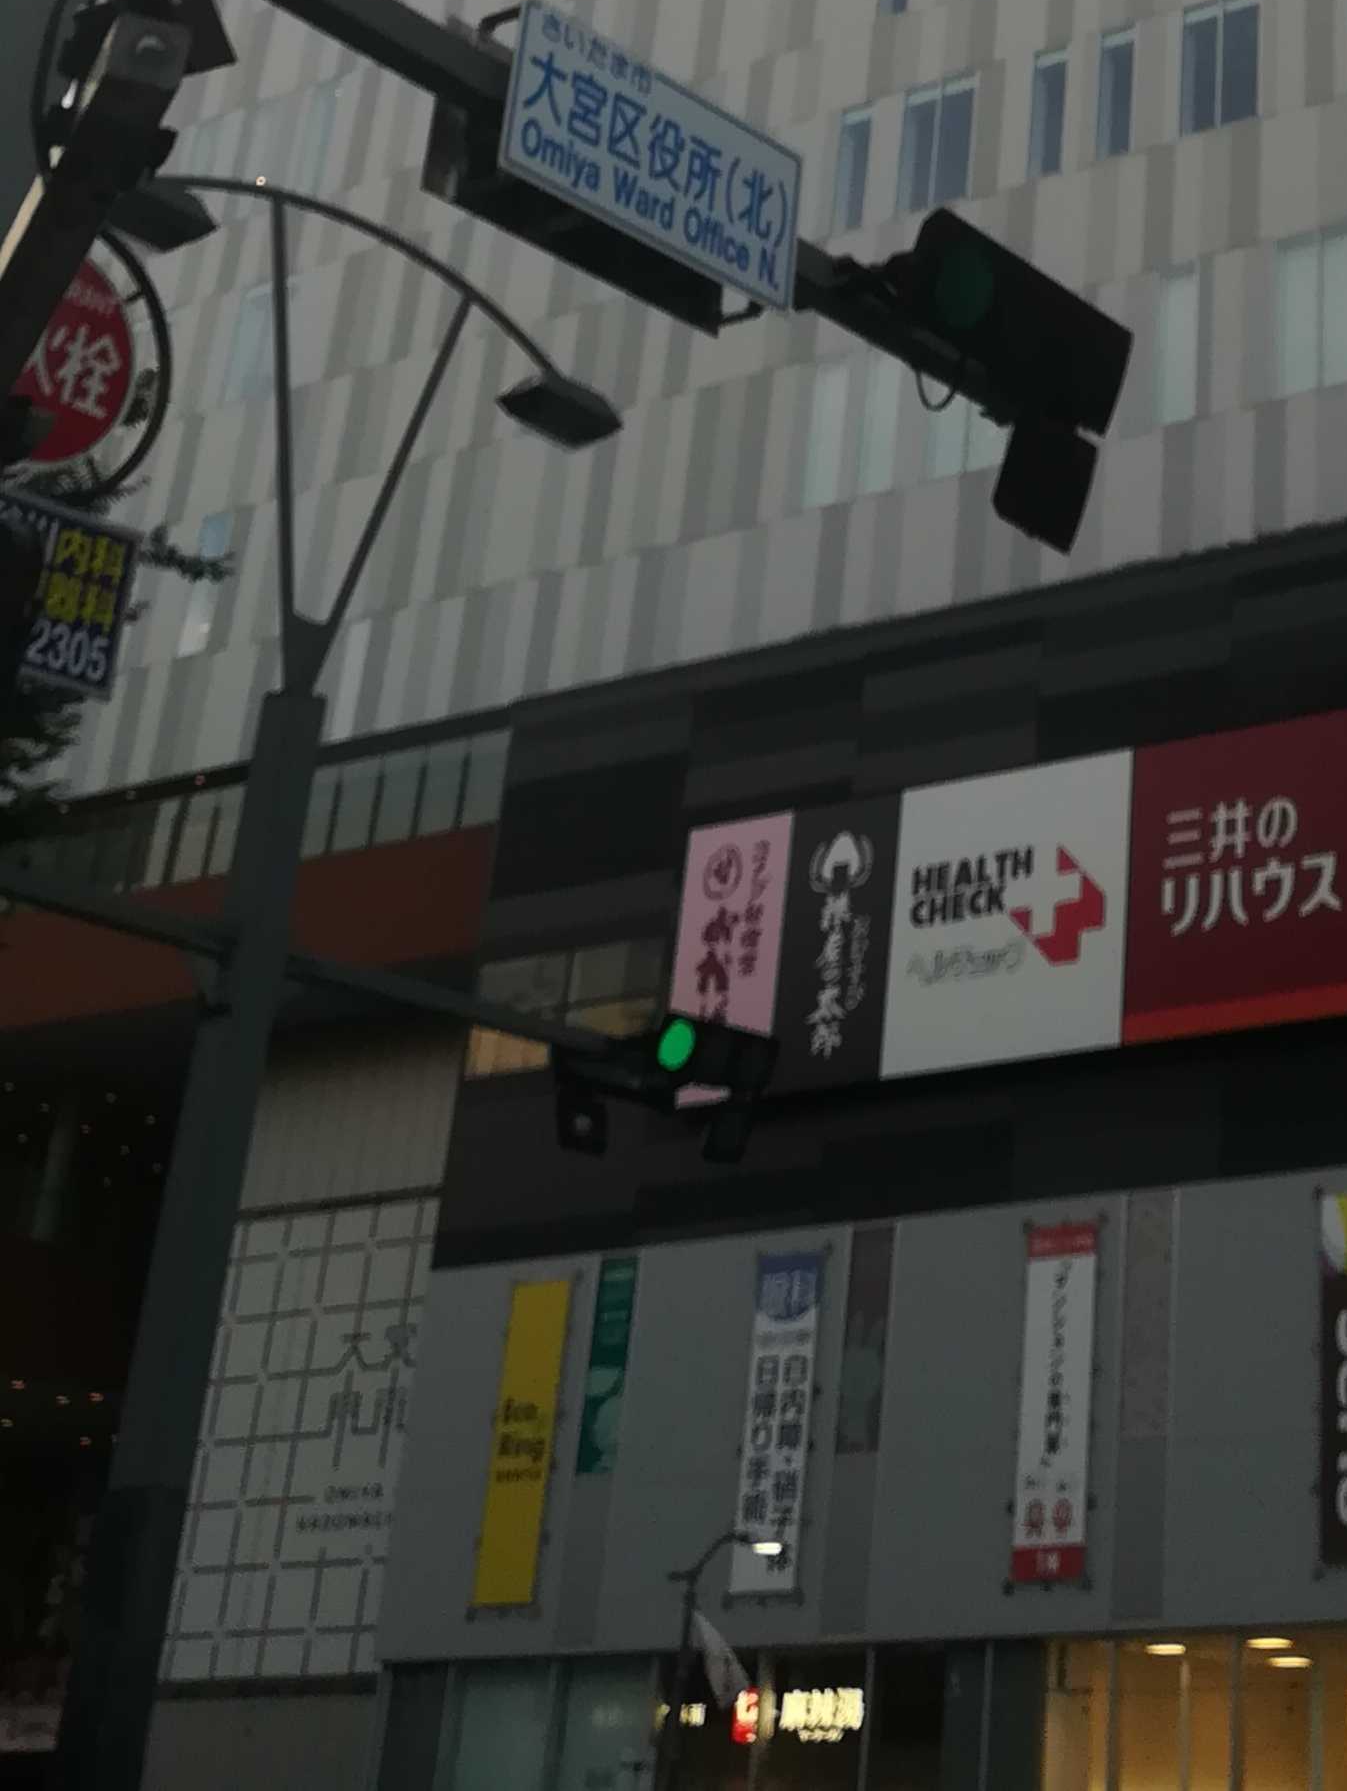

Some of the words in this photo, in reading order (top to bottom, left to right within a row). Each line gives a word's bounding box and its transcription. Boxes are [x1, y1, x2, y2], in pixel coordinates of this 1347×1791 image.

[521, 118, 601, 192] Omiya
[613, 165, 676, 231] Ward
[683, 207, 750, 272] Office
[26, 618, 112, 683] 2305
[1163, 794, 1299, 869] 三井の
[909, 881, 1006, 929] CHECK
[911, 844, 1035, 897] HEALTH
[1160, 850, 1343, 938] リハウス
